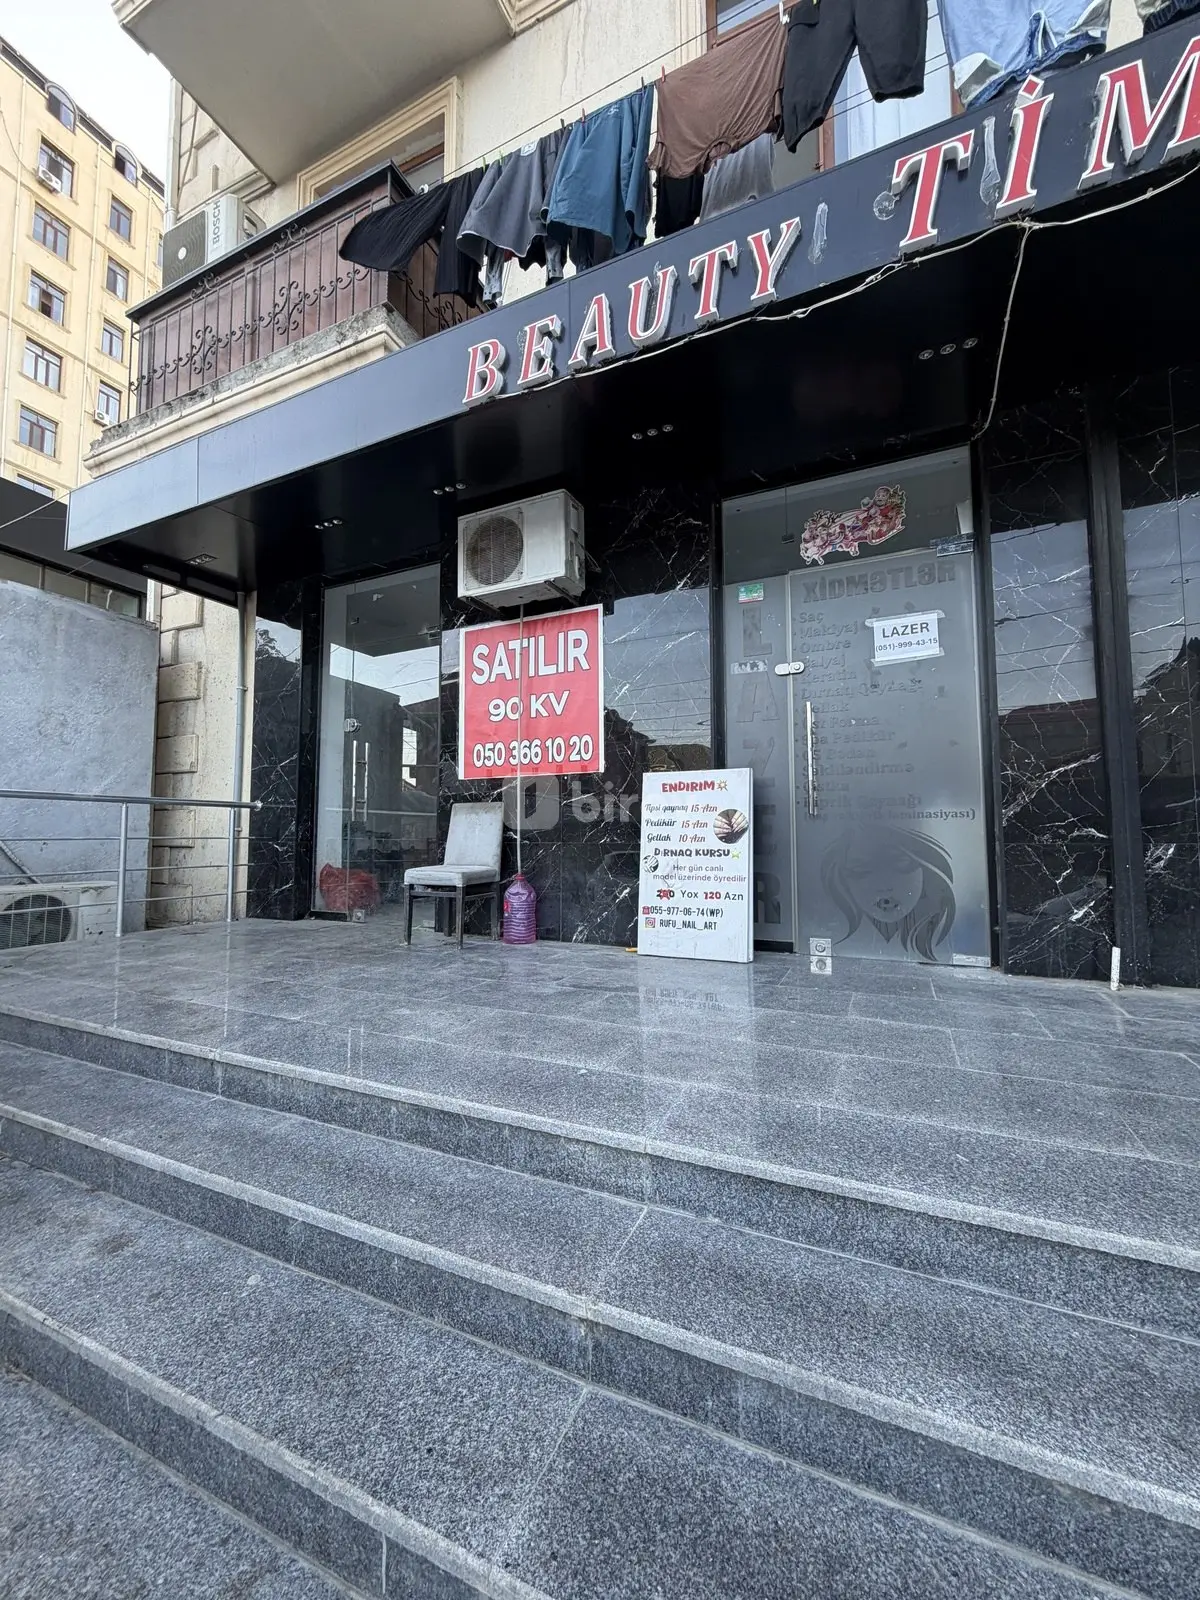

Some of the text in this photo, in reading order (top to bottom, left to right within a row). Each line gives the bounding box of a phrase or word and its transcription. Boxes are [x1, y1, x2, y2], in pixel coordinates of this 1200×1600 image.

[212, 200, 221, 245] BOSCH
[462, 216, 802, 408] BEAUTY
[882, 622, 930, 639] LAZER
[876, 637, 938, 653] (051)-999-43-15
[471, 629, 591, 685] SATILIR
[488, 690, 570, 722] 90 KV
[473, 734, 594, 768] 050 366 10 20
[662, 780, 716, 792] ENDIRIM
[690, 804, 700, 813] 15
[701, 803, 718, 813] Azn
[645, 818, 708, 829] Pedikür 15 Azn
[679, 833, 688, 843] 10
[689, 833, 706, 843] Azn
[695, 848, 731, 857] KURSU
[688, 864, 703, 873] gün
[705, 864, 724, 872] canlı
[680, 890, 699, 899] Yox
[723, 891, 744, 901] Azn
